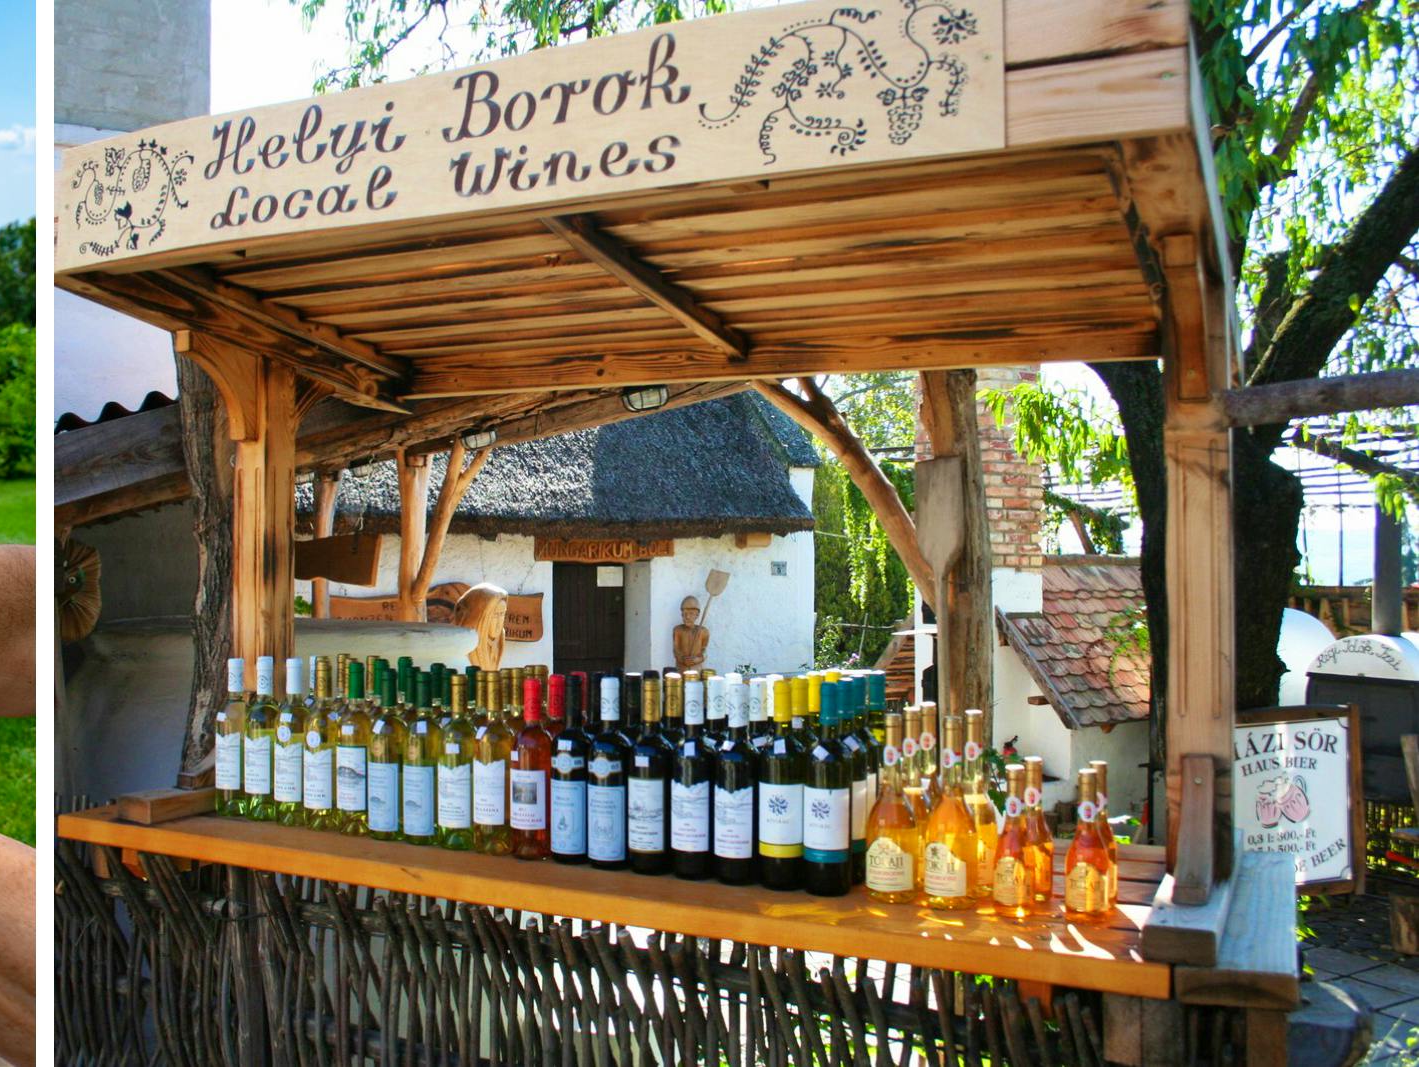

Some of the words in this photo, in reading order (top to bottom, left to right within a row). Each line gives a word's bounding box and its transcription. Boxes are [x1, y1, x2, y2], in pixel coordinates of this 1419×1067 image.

[204, 101, 407, 180] Helyi
[441, 32, 692, 143] Borok
[210, 165, 398, 230] Local
[449, 135, 682, 197] Wines
[1293, 727, 1338, 754] SÖR
[1241, 757, 1281, 777] HAUS
[1285, 756, 1317, 770] BIER
[1305, 828, 1317, 838] Ft
[870, 854, 904, 870] TOAJI
[1310, 838, 1346, 867] BEER
